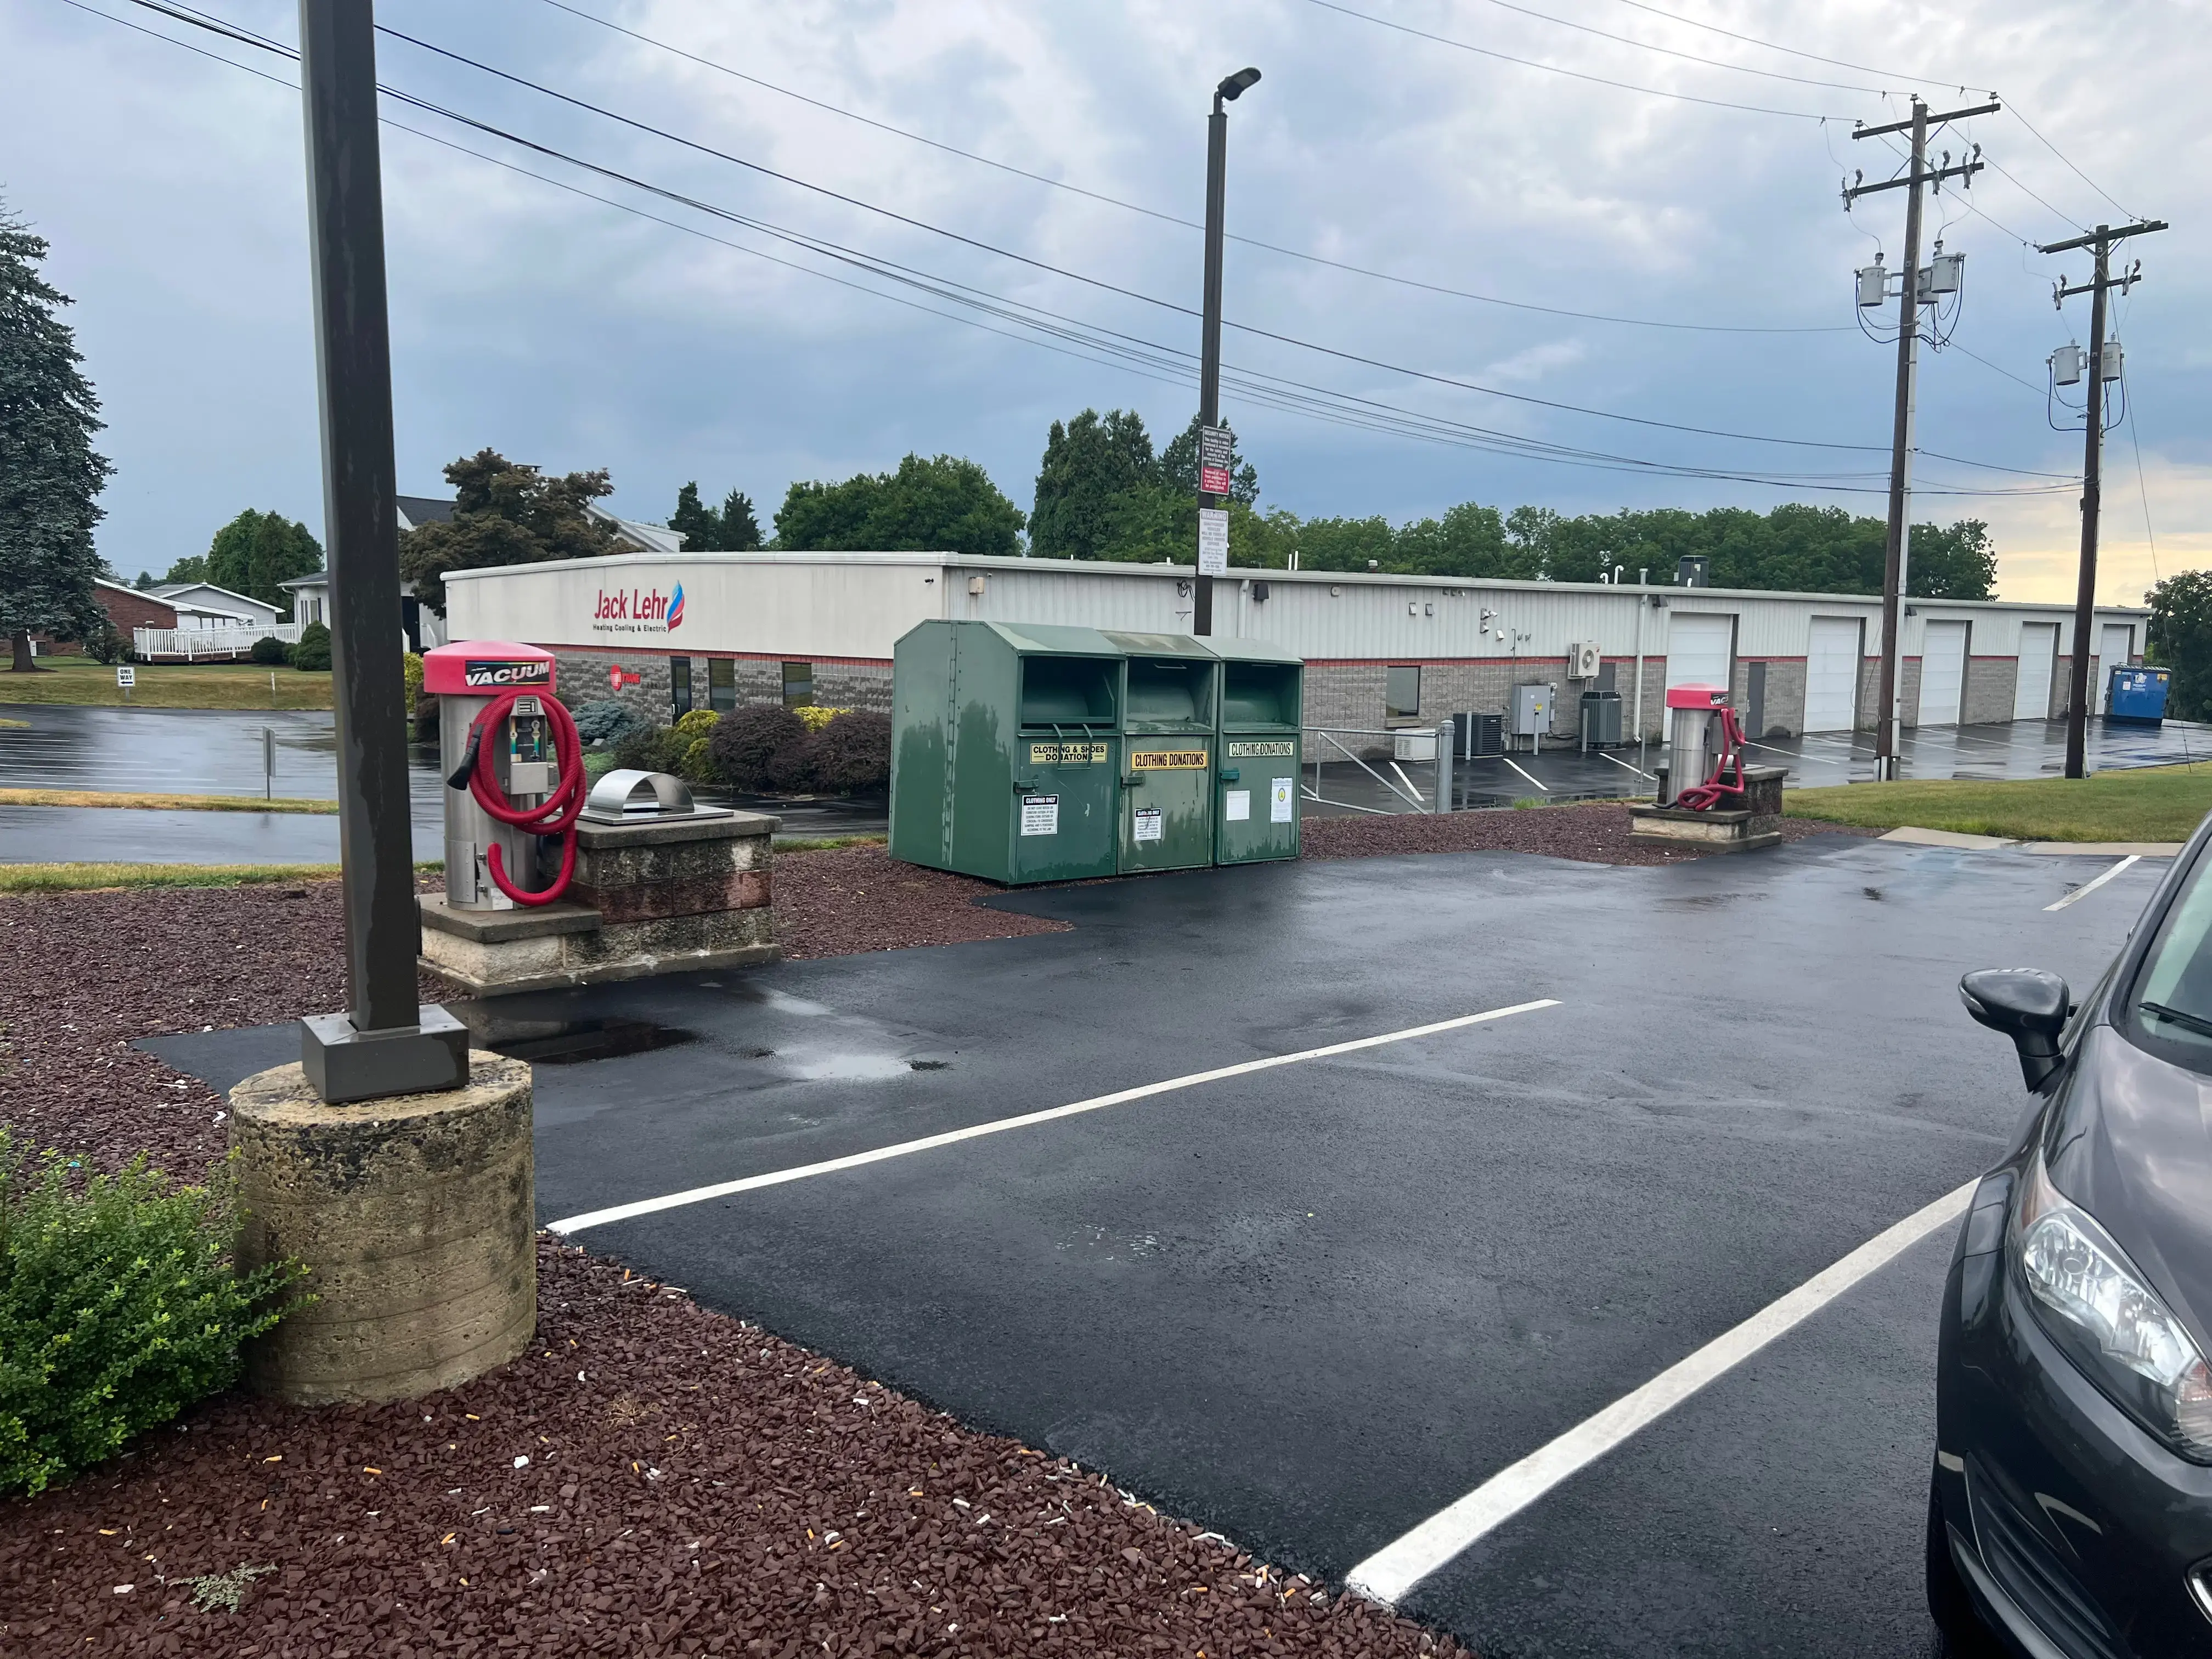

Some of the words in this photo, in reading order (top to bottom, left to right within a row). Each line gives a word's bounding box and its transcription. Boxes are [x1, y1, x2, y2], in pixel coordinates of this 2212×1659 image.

[1201, 511, 1226, 520] WARNING
[594, 589, 628, 619] Jack
[633, 589, 668, 619] Lehr
[465, 661, 550, 686] VACUUM
[1232, 743, 1259, 755] CLOTHING
[1260, 743, 1290, 755] DONATIONS
[1135, 754, 1167, 767] CLOTHING
[1169, 753, 1204, 766] DONATIONS
